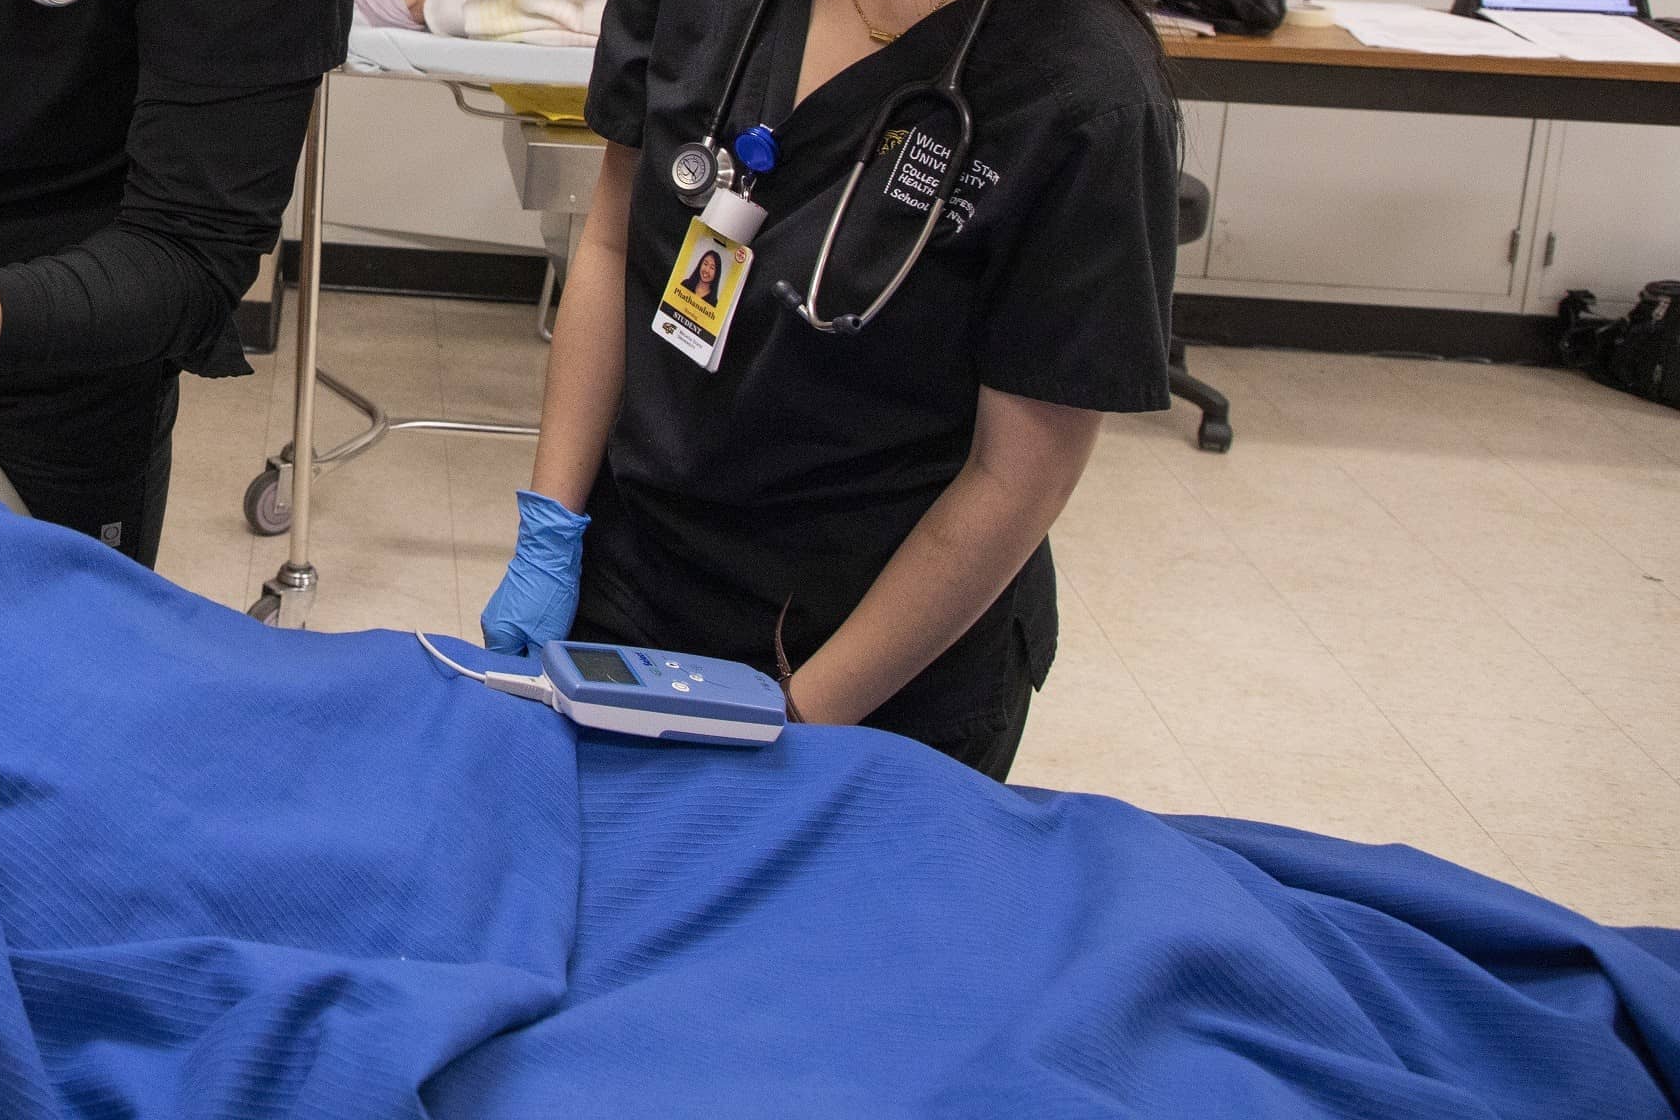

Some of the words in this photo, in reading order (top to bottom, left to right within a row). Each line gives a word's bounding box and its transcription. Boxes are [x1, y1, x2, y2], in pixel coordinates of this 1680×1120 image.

[897, 173, 935, 197] HEALTH
[890, 188, 931, 212] School
[672, 310, 704, 335] STUDENT
